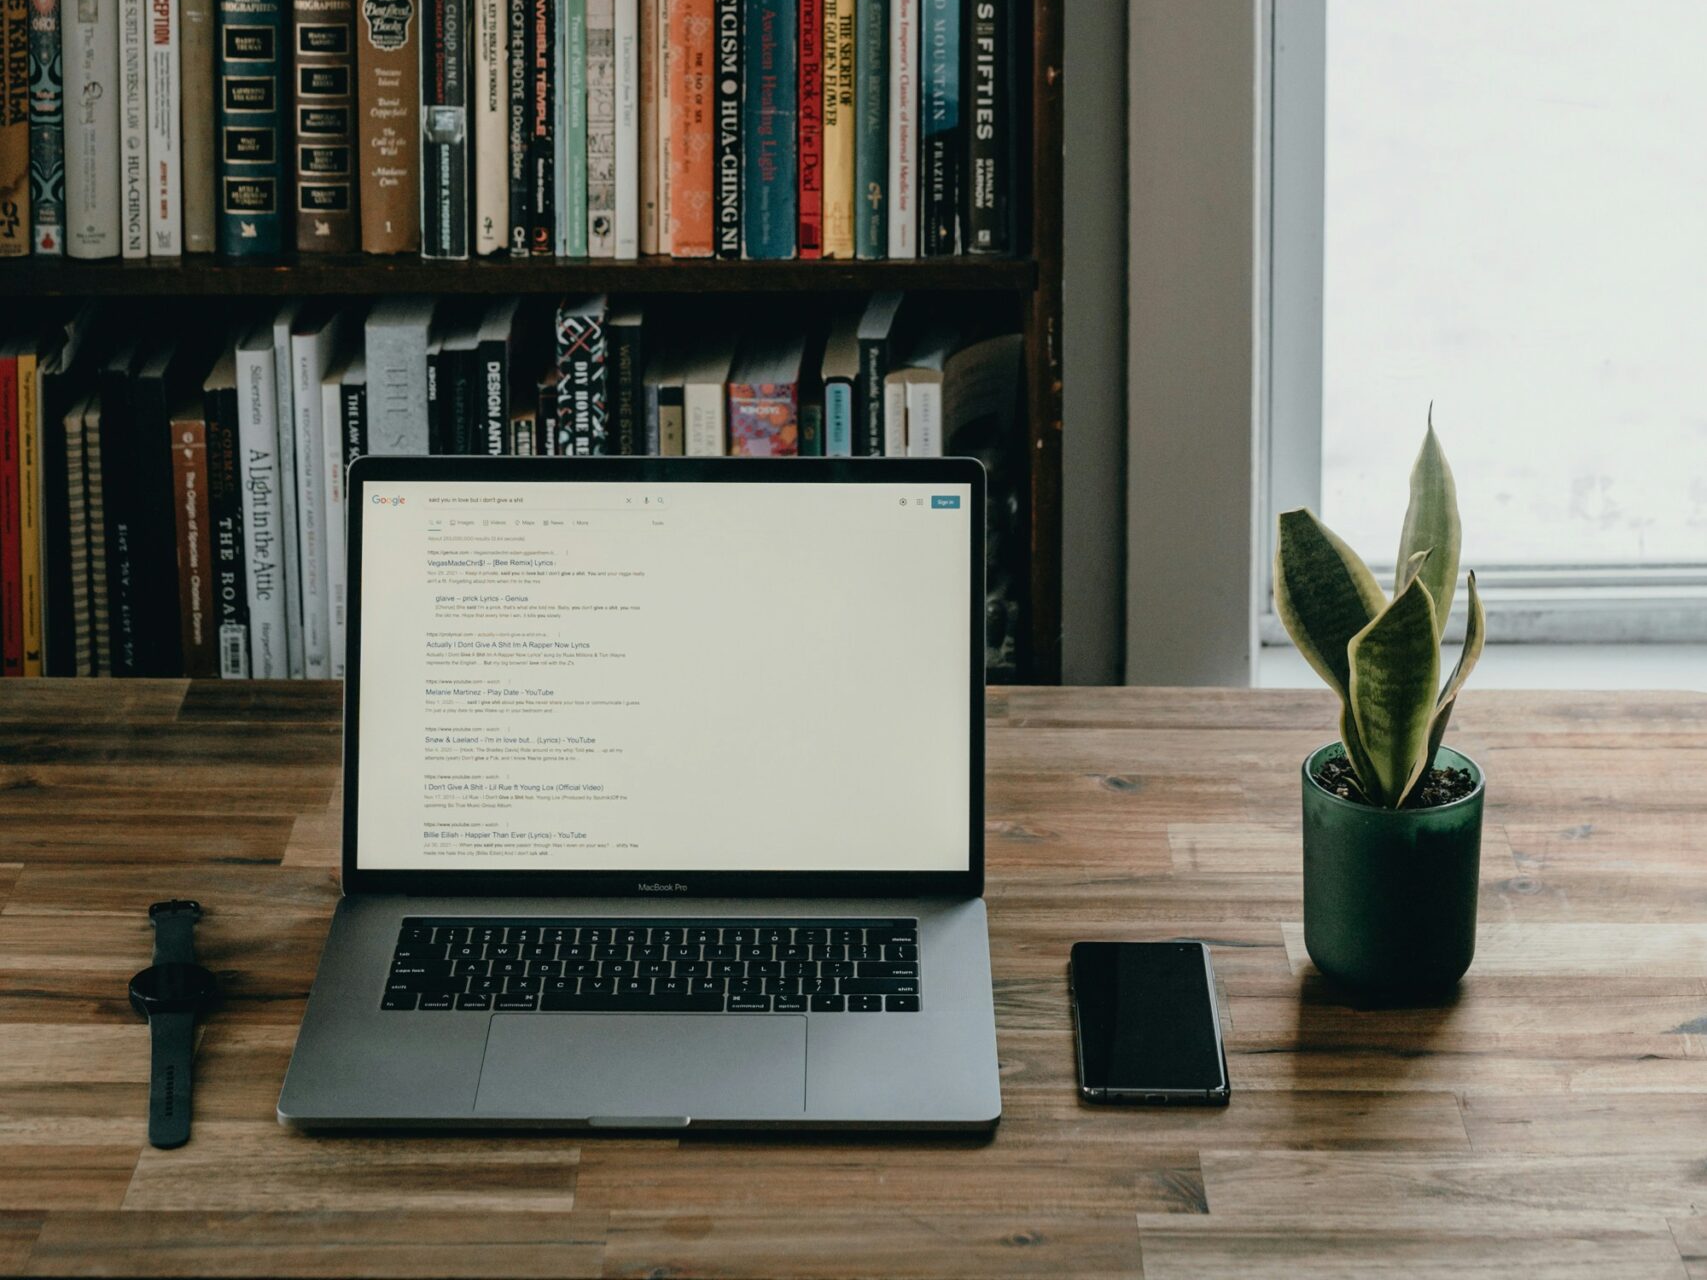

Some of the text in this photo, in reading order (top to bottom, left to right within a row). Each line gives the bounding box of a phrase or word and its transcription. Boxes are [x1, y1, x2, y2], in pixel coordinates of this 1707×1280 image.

[126, 6, 138, 44] SUBTLE
[221, 2, 278, 12] BIOGRAPHIES
[294, 0, 351, 10] BIOGRAPHIES
[512, 12, 524, 29] OF
[446, 4, 457, 89] CLOUD NINE
[512, 29, 524, 47] THE
[571, 15, 581, 42] Trees
[762, 9, 777, 70] Awaken
[826, 21, 837, 73] GOLDEN
[898, 22, 910, 72] Emperor's
[8, 20, 28, 126] KABALA
[127, 47, 139, 105] UNIVERSAL
[512, 48, 524, 78] THIRD
[572, 56, 581, 85] North
[840, 14, 851, 106] THE SECRET OF
[933, 20, 946, 120] MOUNTAIN
[512, 79, 524, 99] EYE
[695, 94, 703, 105] OF
[803, 62, 819, 100] Book
[826, 74, 837, 126] FLOWER
[899, 74, 910, 109] Classic
[976, 38, 994, 140] FIFTIES
[128, 107, 139, 128] LAW
[536, 71, 547, 136] TEMPLE
[572, 87, 581, 128] America
[758, 75, 777, 135] Healing
[803, 106, 819, 125] of
[900, 111, 909, 122] of
[803, 125, 819, 148] the
[899, 124, 909, 163] Internal
[441, 143, 449, 186] SANDRA
[721, 100, 738, 250] HUA-CHING NI
[758, 140, 777, 182] Light
[803, 153, 819, 192] Dead
[933, 141, 943, 201] FRAZIER
[128, 155, 141, 250] HUA-CHING NI
[899, 166, 909, 212] Medicine
[975, 158, 985, 209] KARNOW
[985, 158, 994, 209] STANLEY
[250, 365, 263, 425] Silverstein
[487, 361, 501, 417] DESIGN
[574, 361, 589, 432] DIY HOME
[620, 344, 632, 415] WRITE THE
[347, 393, 360, 446] THE LAW
[186, 472, 196, 488] The
[371, 494, 406, 506] Google
[186, 490, 197, 519] Origin
[188, 520, 198, 530] of
[245, 449, 276, 601] A Light in the Attic
[188, 531, 199, 568] Species
[219, 518, 233, 560] THE
[534, 559, 554, 568] Lyrics
[426, 641, 451, 650] Actually
[529, 641, 553, 650] Rapper
[571, 641, 590, 650] Lyrics
[425, 688, 554, 697] Melanie Martinez Play Date YouTube
[638, 883, 688, 892] MacBook Pro
